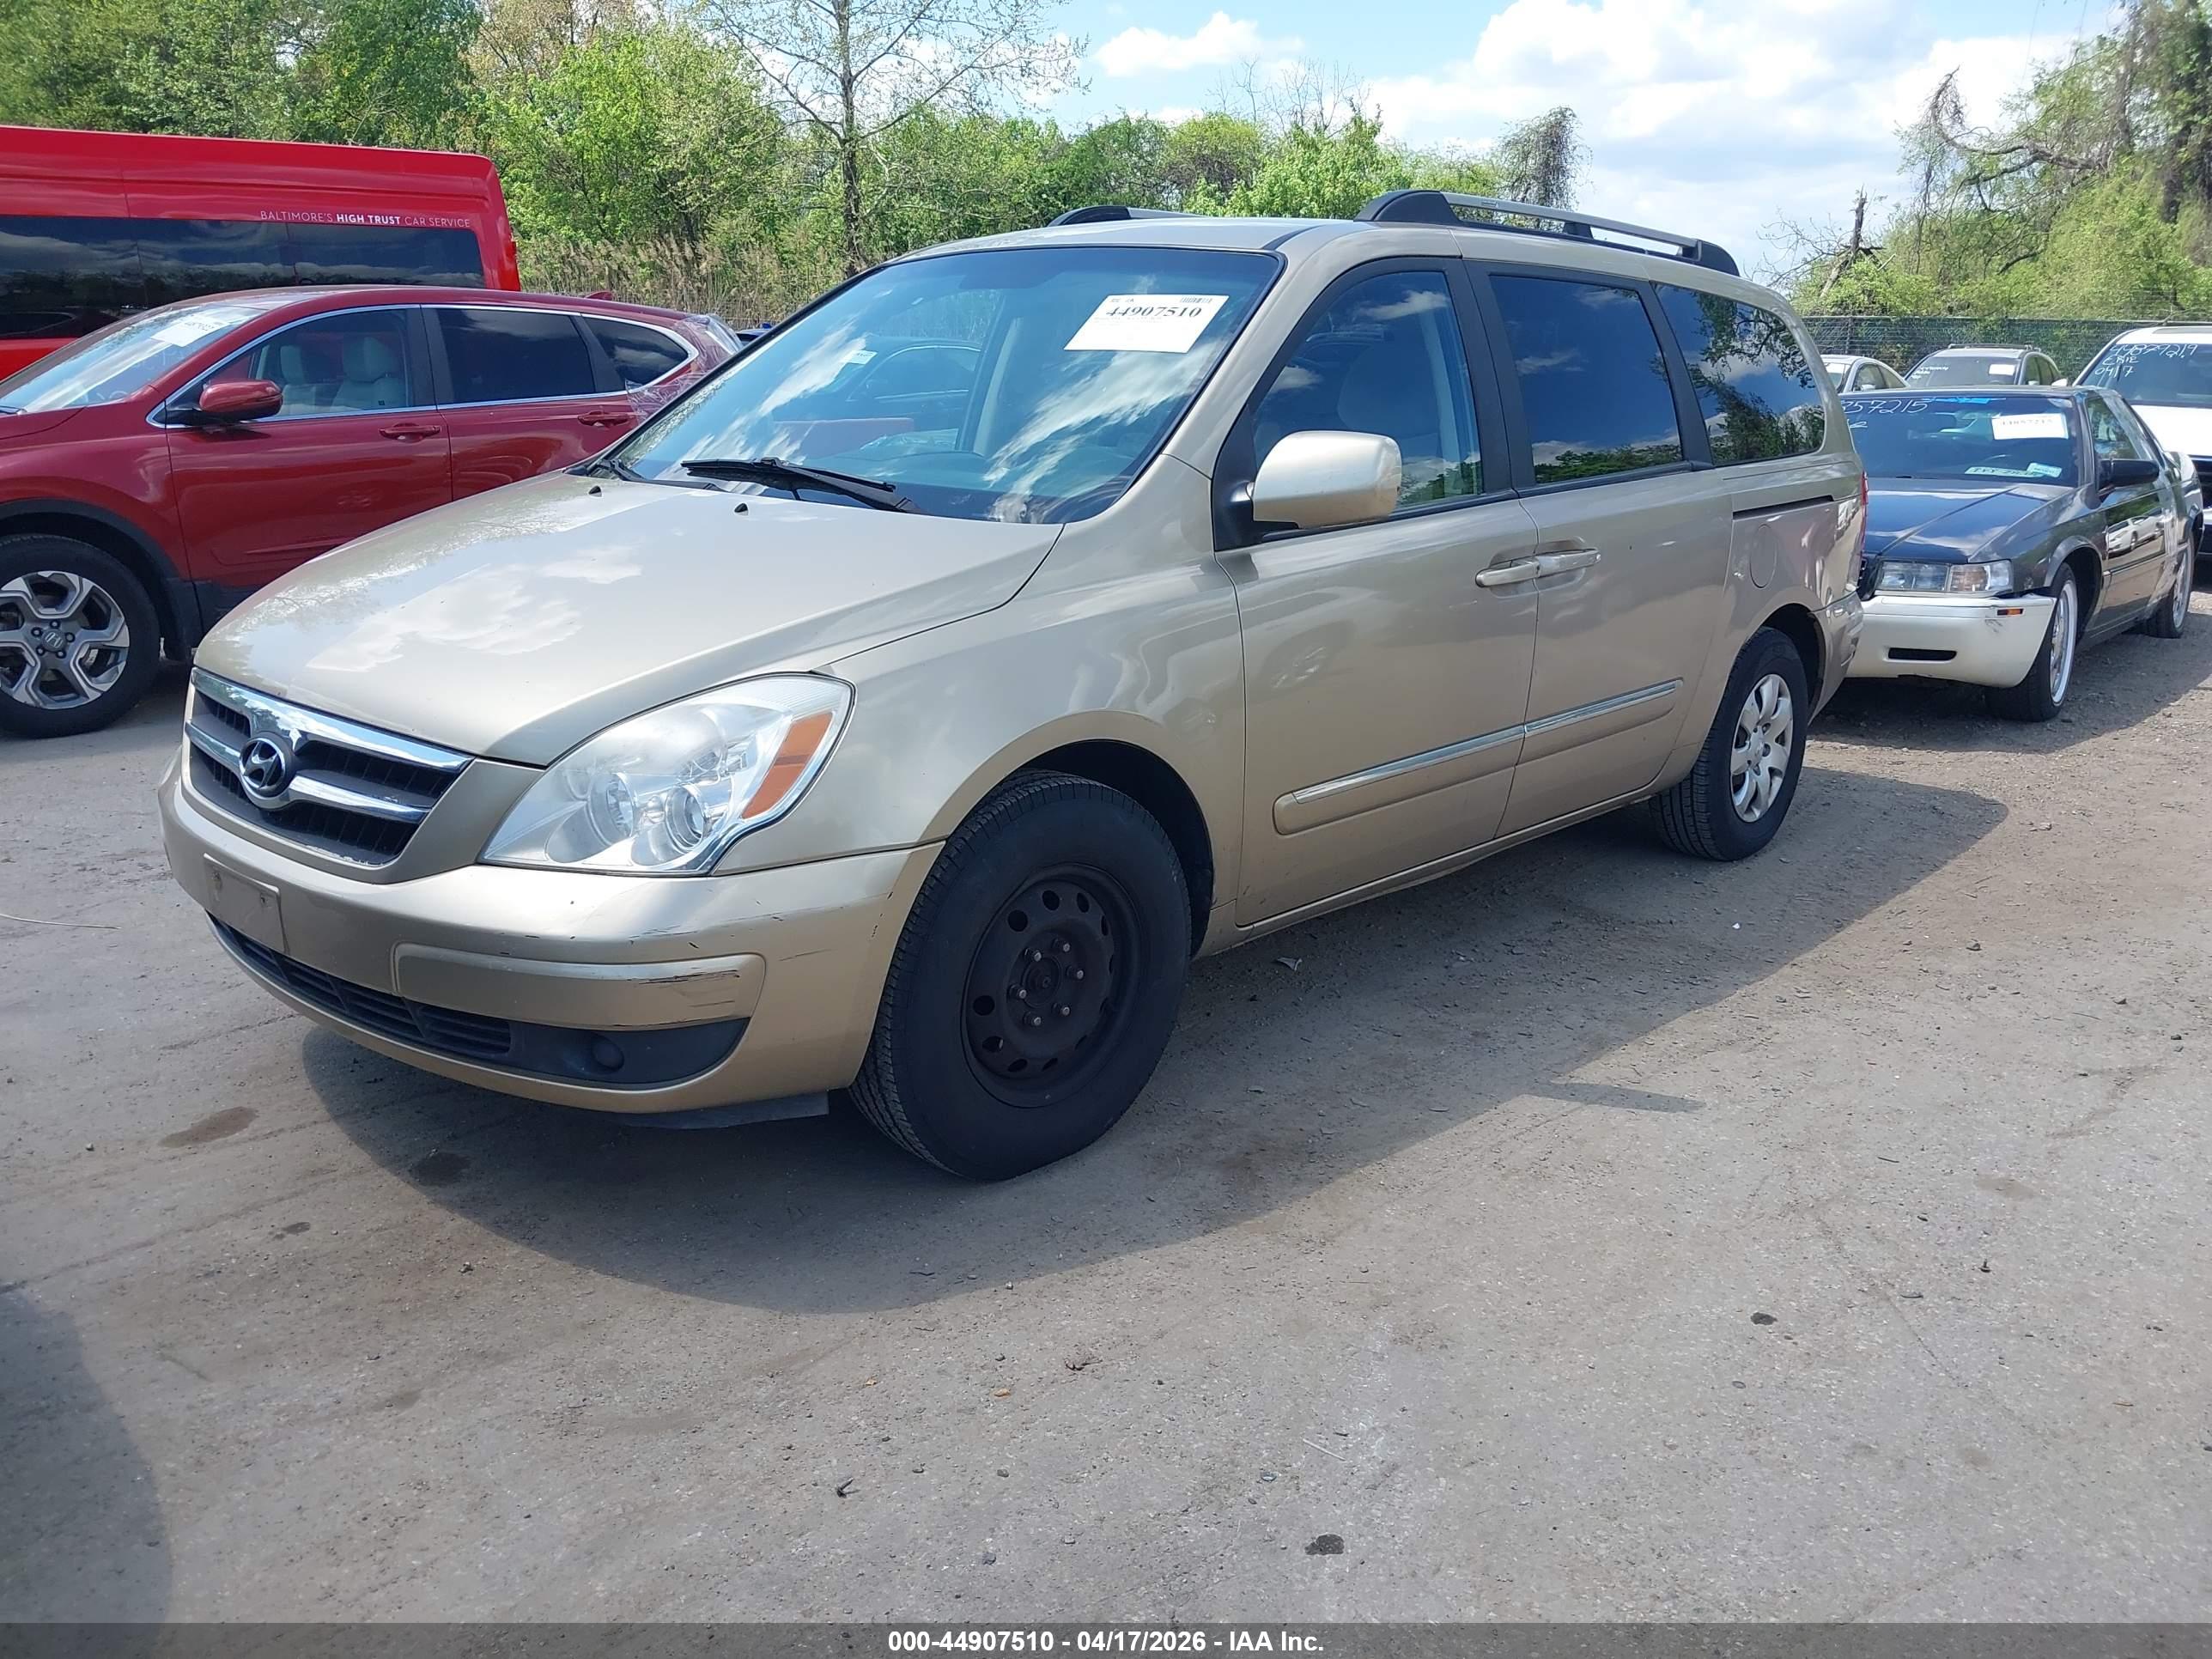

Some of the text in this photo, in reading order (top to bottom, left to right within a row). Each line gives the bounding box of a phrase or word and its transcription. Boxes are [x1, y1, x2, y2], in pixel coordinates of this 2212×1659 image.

[260, 210, 471, 228] BALTIMORE'S HIGH TRUST CAR SERVICE
[1105, 306, 1202, 318] 44907510
